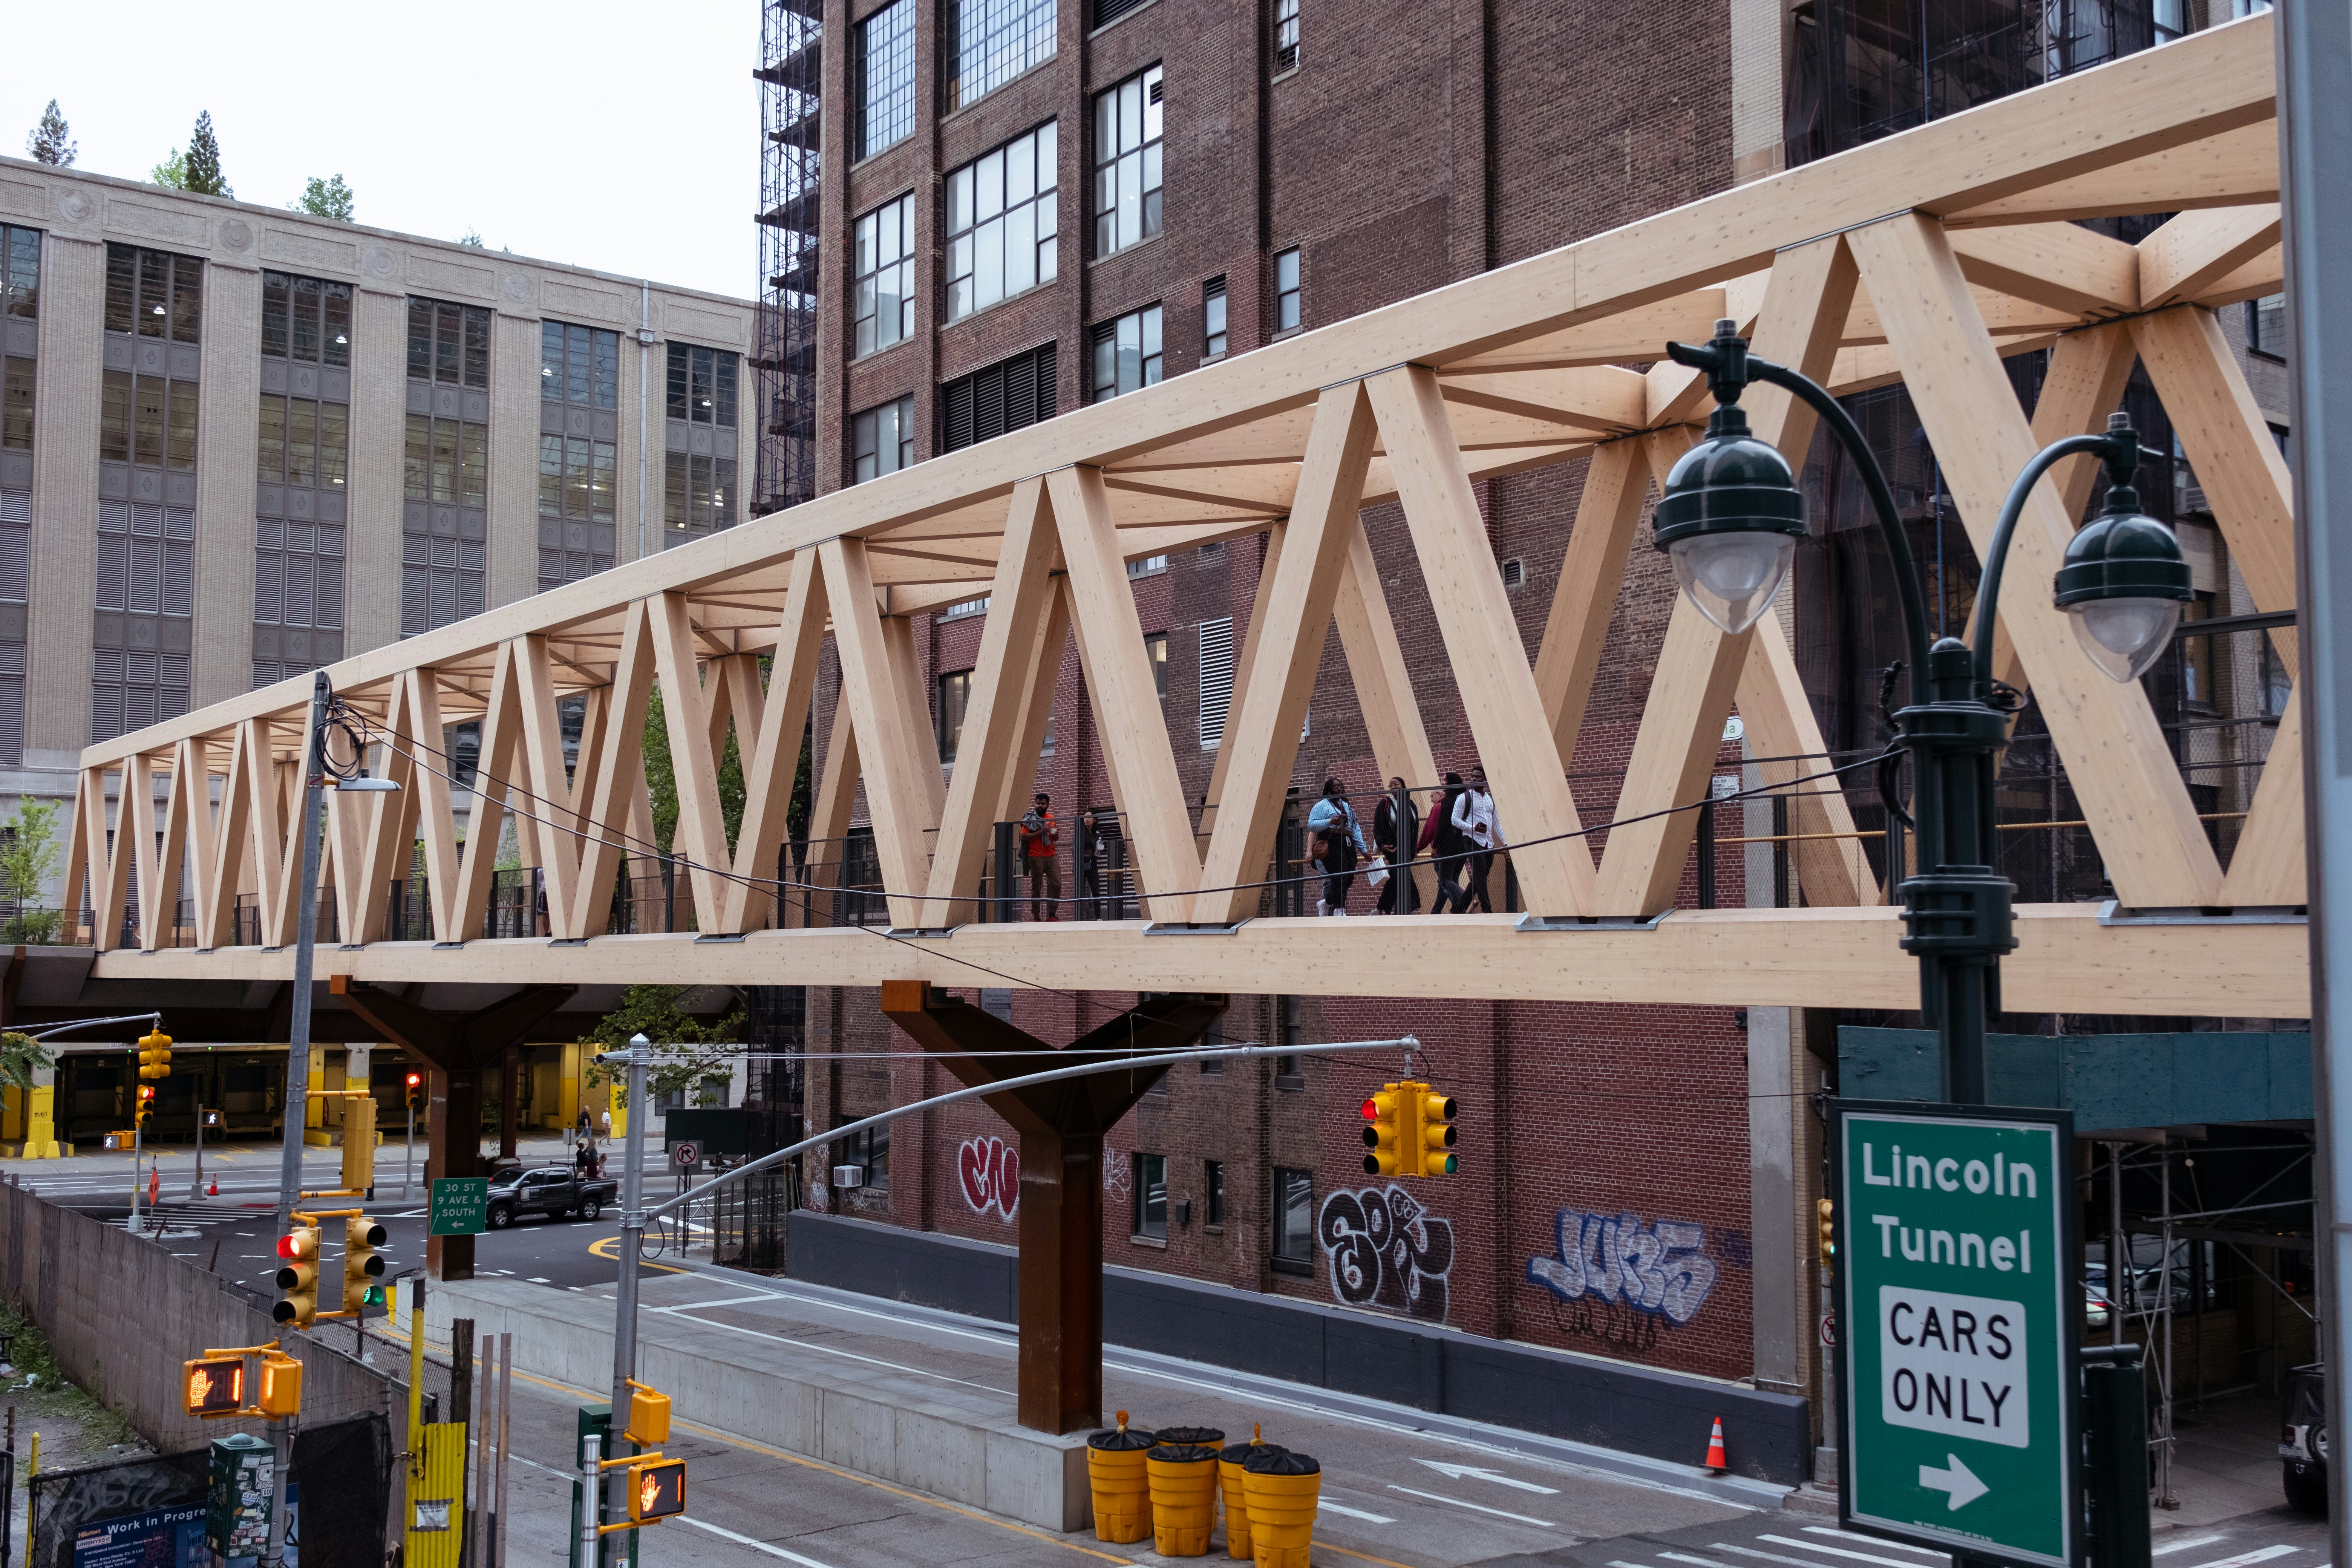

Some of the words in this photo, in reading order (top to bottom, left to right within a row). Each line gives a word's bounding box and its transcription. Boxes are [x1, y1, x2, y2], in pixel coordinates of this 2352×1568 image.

[1863, 1142, 2037, 1198] Lincoln
[445, 1184, 458, 1192] 30
[464, 1183, 476, 1191] ST
[438, 1196, 444, 1205] 9
[449, 1196, 469, 1204] AVE
[442, 1208, 476, 1217] SOUTH
[1871, 1214, 2031, 1274] Tunnel
[1890, 1302, 2012, 1360] CARS
[1891, 1367, 2012, 1427] ONLY
[107, 1520, 141, 1534] Work
[146, 1517, 158, 1527] in
[84, 1547, 107, 1556] Anticipated
[108, 1542, 133, 1551] Completion:
